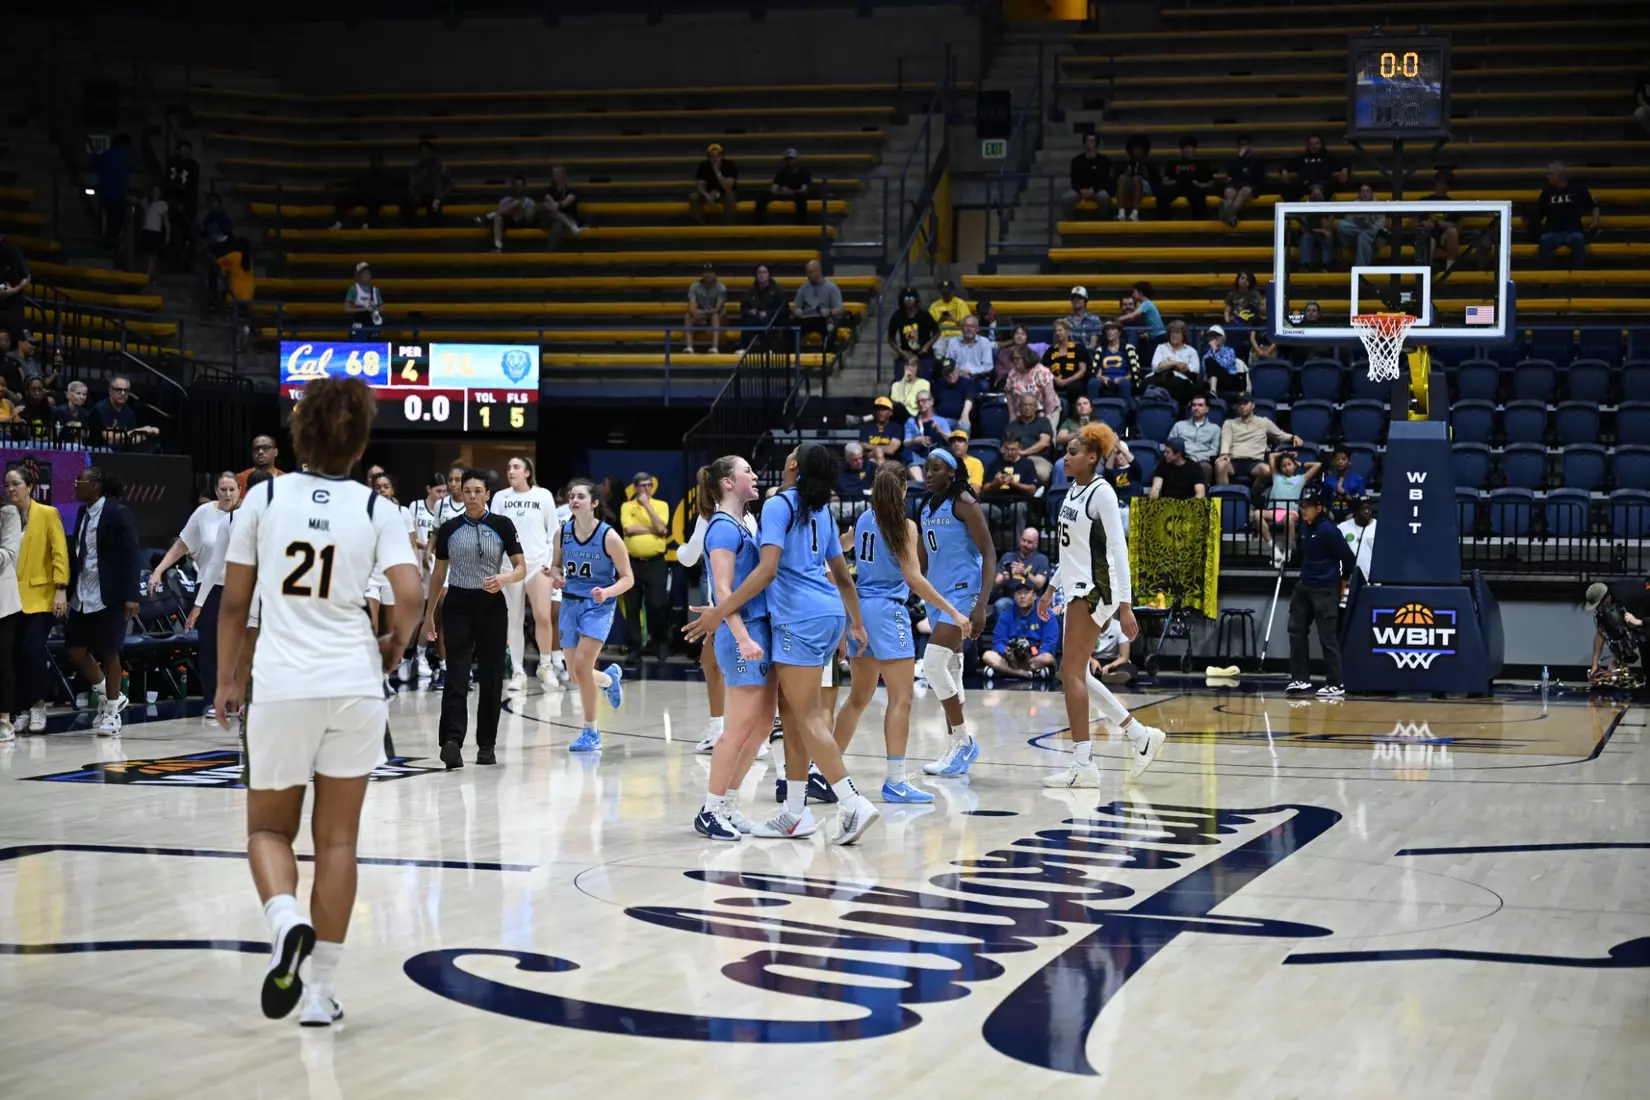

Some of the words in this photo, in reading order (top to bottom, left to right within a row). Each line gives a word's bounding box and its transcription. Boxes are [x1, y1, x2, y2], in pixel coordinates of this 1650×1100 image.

[1381, 52, 1418, 78] 0.0
[985, 142, 1004, 156] EXIT
[286, 344, 333, 381] Cal
[346, 351, 380, 376] 68
[399, 347, 422, 357] PER
[401, 360, 419, 382] 4
[404, 395, 450, 421] 0.0
[507, 392, 528, 404] FLS
[479, 406, 490, 428] 1
[510, 406, 524, 428] 5
[1406, 471, 1428, 534] WBIT
[309, 518, 330, 531] MAUL
[811, 518, 818, 552] 1
[859, 530, 876, 563] 11
[927, 529, 938, 552] 0
[282, 541, 335, 599] 21
[566, 560, 593, 578] 24
[895, 611, 907, 648] LIONS
[1373, 627, 1456, 646] WBIT
